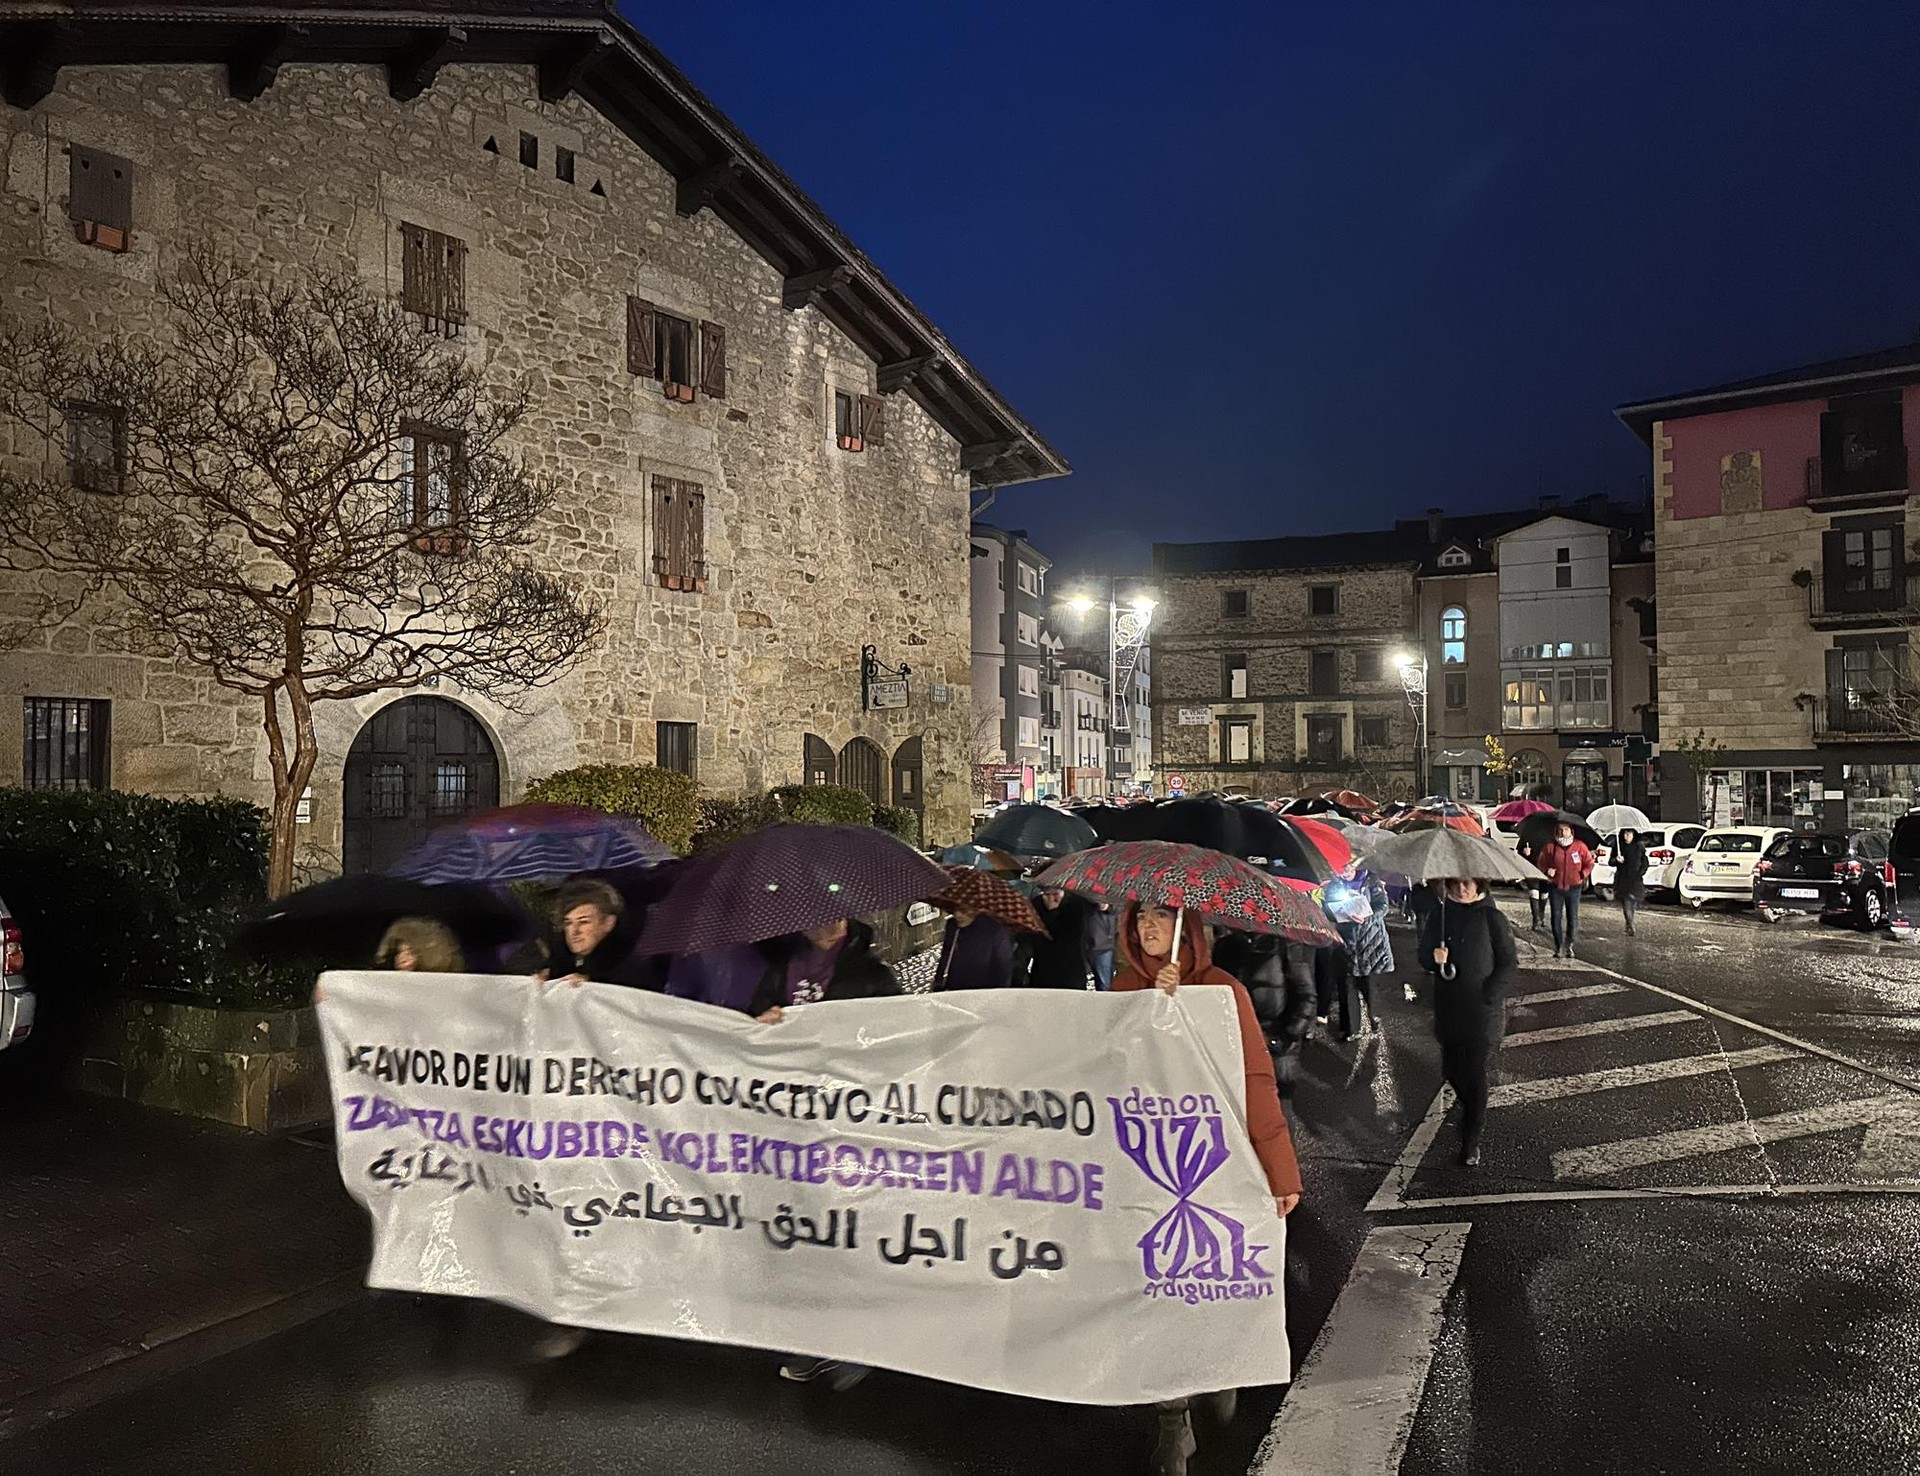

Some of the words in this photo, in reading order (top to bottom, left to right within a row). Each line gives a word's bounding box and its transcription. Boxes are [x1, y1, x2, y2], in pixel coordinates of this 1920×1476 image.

[870, 683, 906, 694] AMEZTIA
[454, 1052, 490, 1091] DE
[496, 1054, 531, 1095] UN
[879, 1082, 932, 1124] AL
[1123, 1086, 1221, 1116] denon
[474, 1114, 650, 1160] ESKUBIDE
[654, 1127, 985, 1195] KOLEKTIBOAREN
[990, 1152, 1104, 1210] ALDE
[1106, 1096, 1232, 1199] bizi
[760, 1203, 856, 1251] الحق
[989, 1229, 1065, 1279] من
[1142, 1279, 1274, 1305] erdigunean
